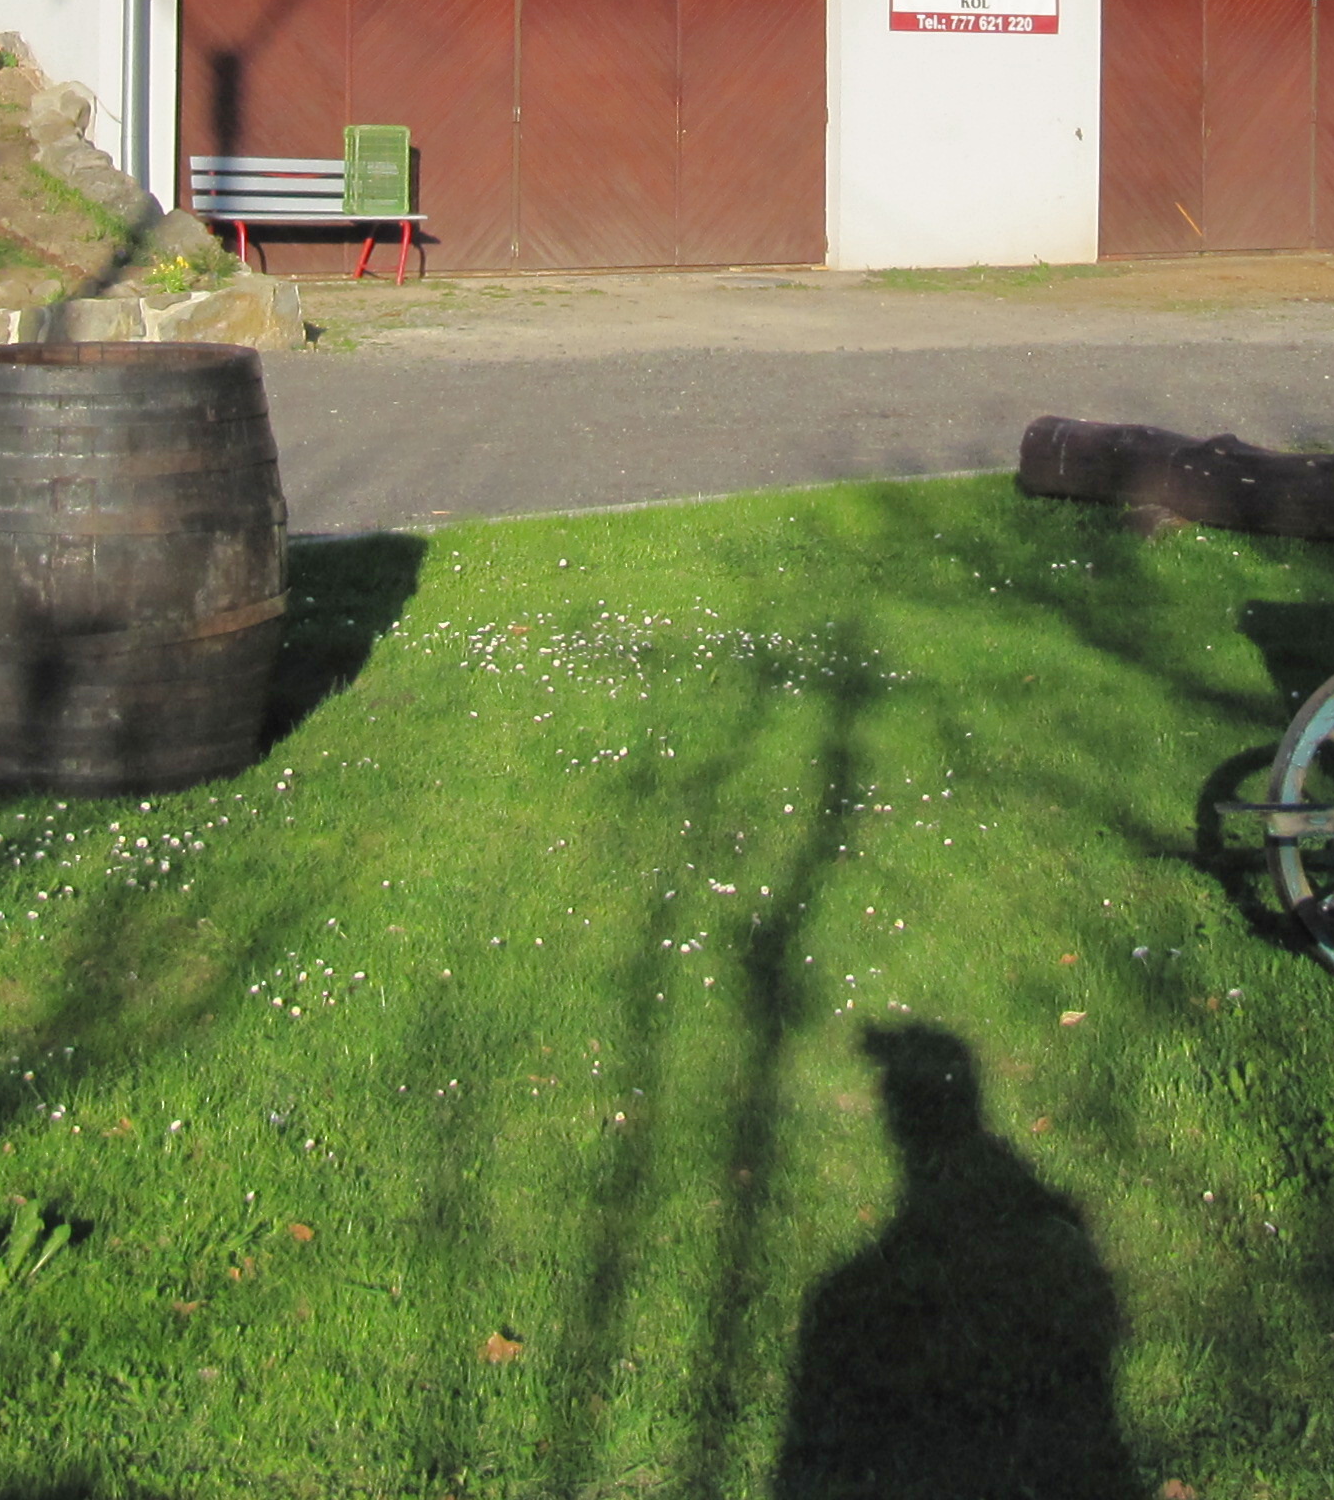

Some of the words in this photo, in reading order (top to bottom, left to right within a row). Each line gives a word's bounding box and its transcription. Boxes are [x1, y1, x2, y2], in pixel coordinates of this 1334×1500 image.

[916, 15, 946, 30] Tel.:
[950, 16, 975, 31] 777
[979, 17, 1003, 32] 621
[1008, 17, 1033, 32] 220
